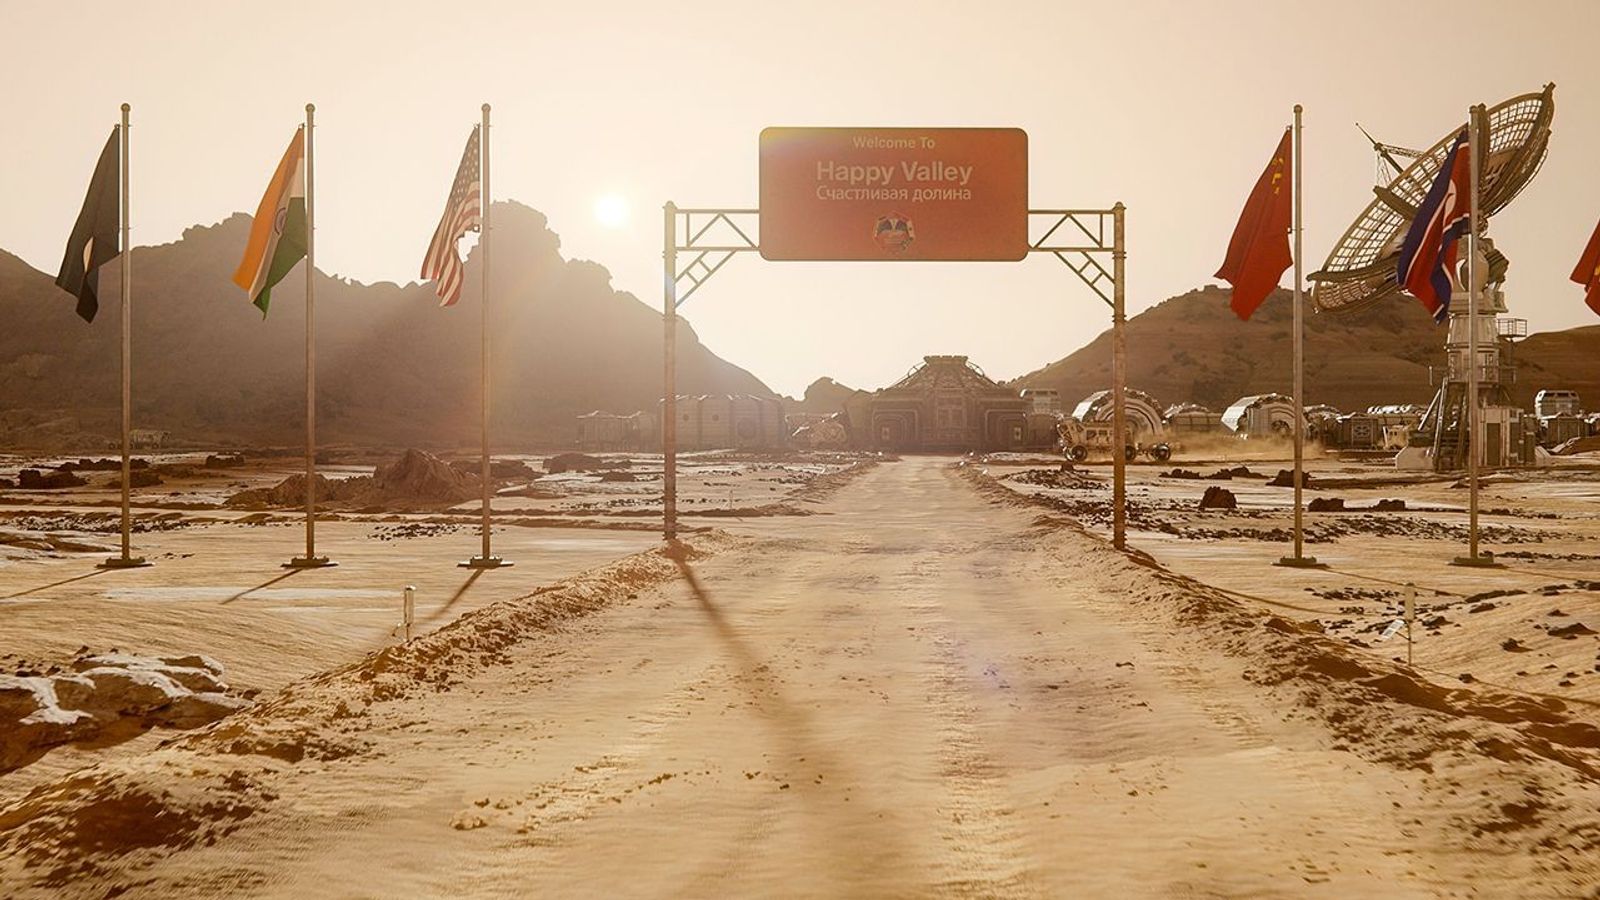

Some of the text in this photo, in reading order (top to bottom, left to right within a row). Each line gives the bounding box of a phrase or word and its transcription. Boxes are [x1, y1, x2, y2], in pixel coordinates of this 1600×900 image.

[853, 136, 936, 149] Welcome To
[817, 160, 973, 186] Happy Valley
[816, 185, 972, 202] Счастливая долина
